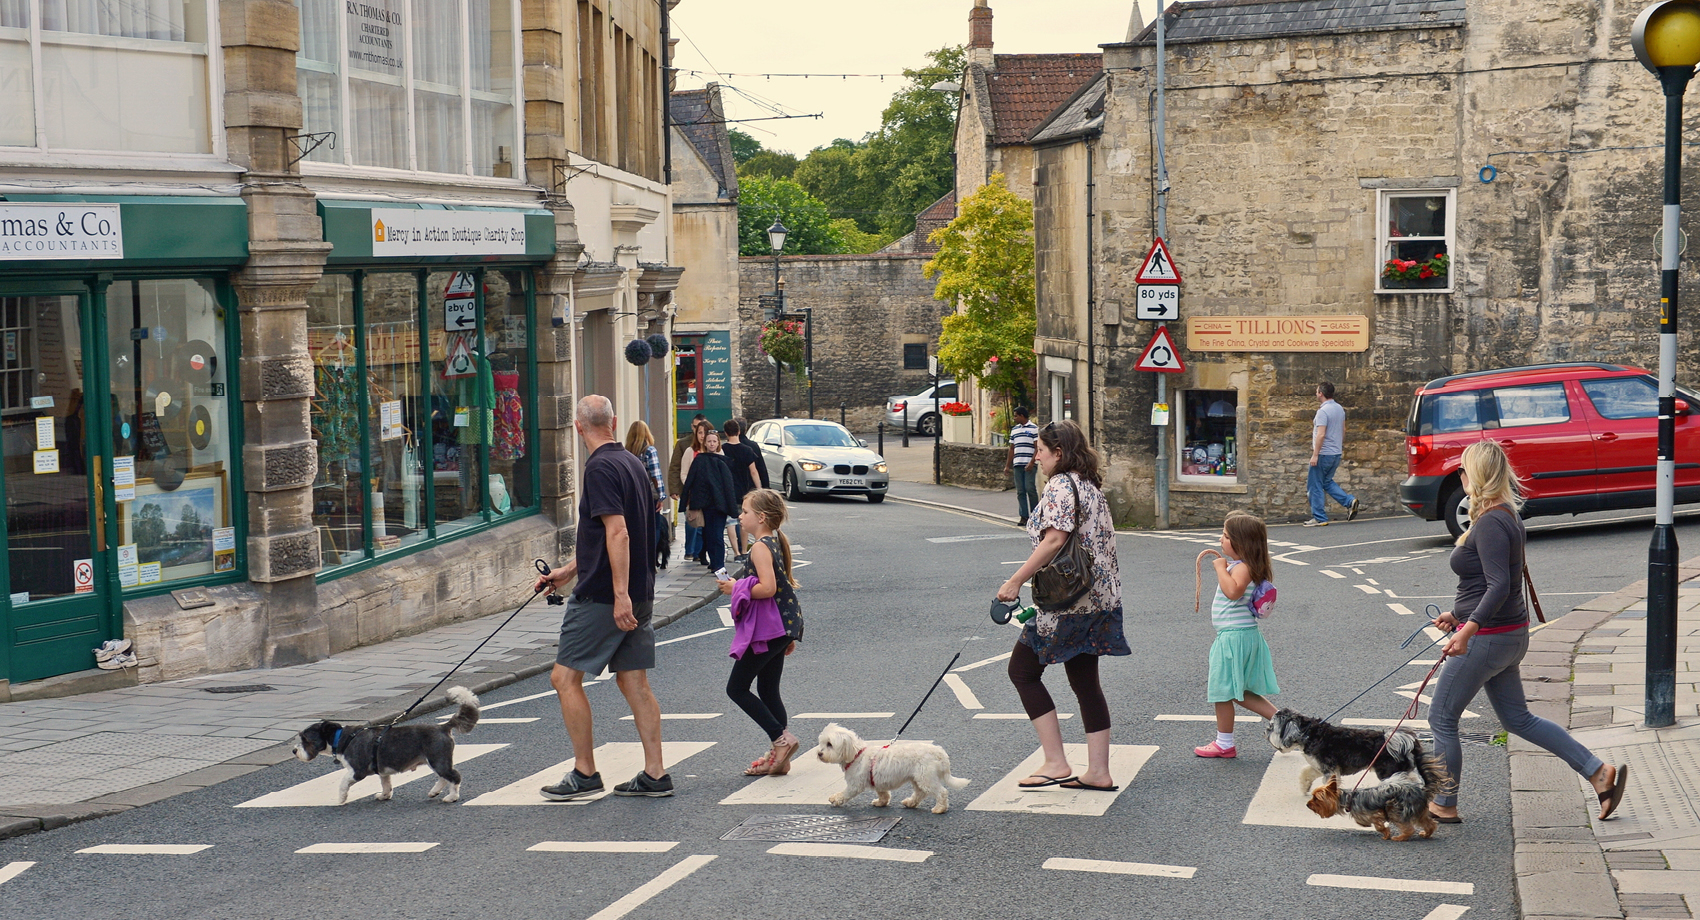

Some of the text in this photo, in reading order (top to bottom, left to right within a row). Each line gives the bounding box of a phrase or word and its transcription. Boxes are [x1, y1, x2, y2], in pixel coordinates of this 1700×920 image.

[360, 4, 385, 21] THOMAS
[386, 10, 391, 23] &
[392, 12, 402, 25] CO.
[361, 22, 389, 37] CHARTERED
[359, 34, 393, 50] ACCOUNTANTS
[55, 212, 74, 236] &
[81, 212, 116, 236] Co.
[387, 226, 524, 245] Mercy in Action Boutique Charity Shop
[2, 240, 117, 251] ACCOUNTANTS
[1141, 289, 1176, 300] 80 yds
[1236, 320, 1316, 335] TILLIONS
[1200, 339, 1355, 349] The Fine China, Crystal and Cookware Specialists
